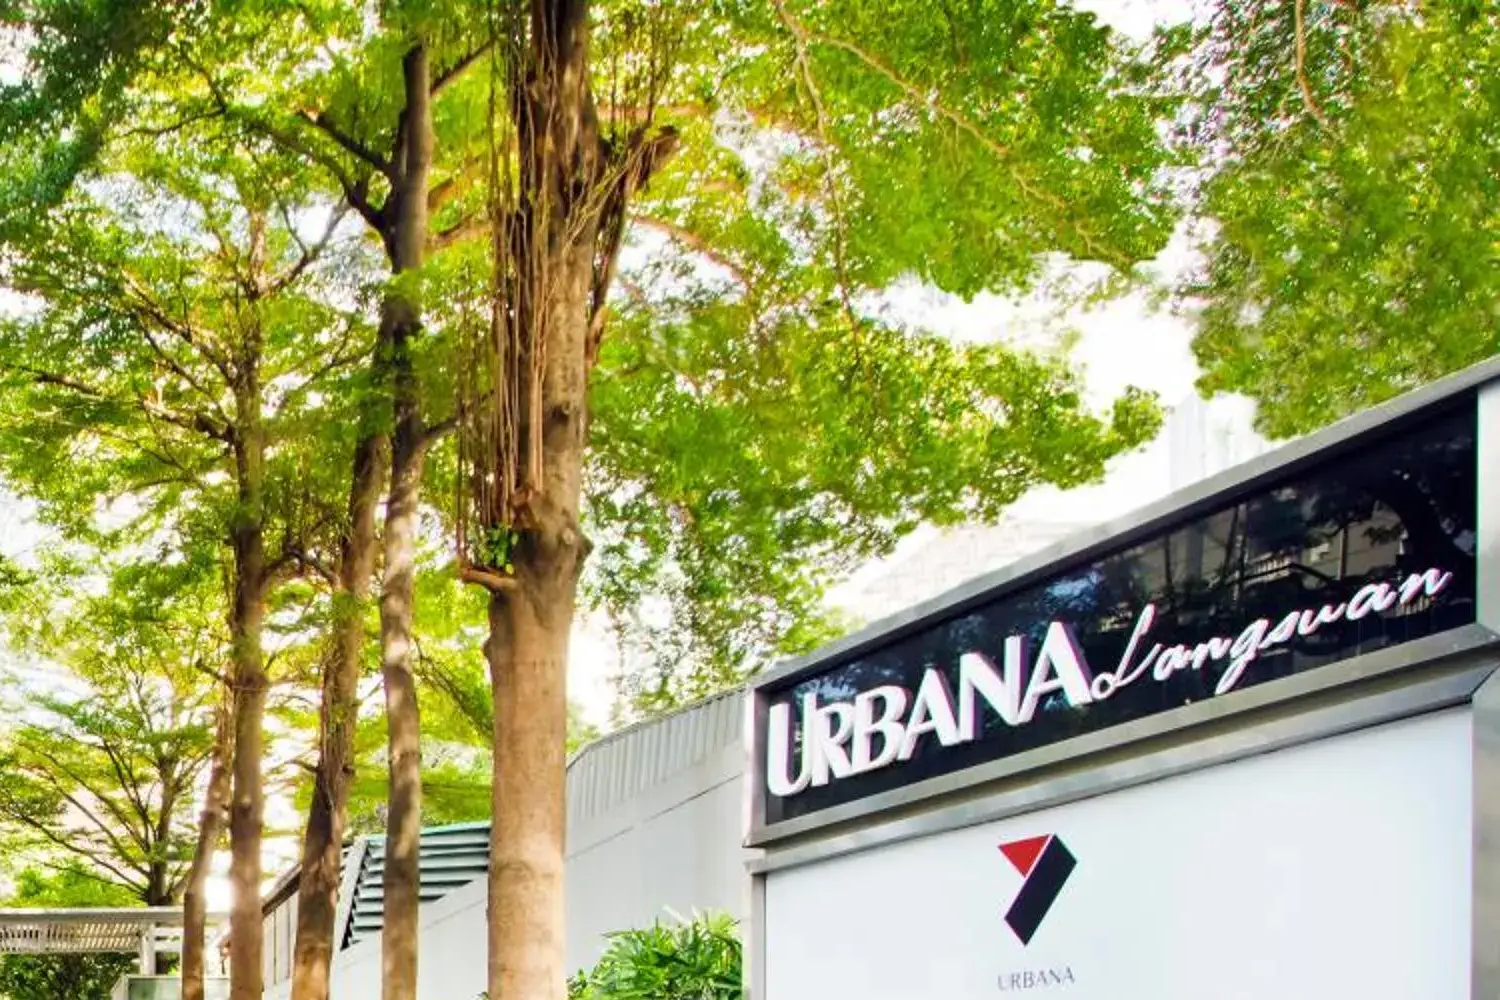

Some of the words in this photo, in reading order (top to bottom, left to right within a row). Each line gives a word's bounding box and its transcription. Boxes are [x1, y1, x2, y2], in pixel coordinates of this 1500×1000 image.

[766, 622, 1094, 798] URBANA
[1091, 566, 1453, 694] Langsuan
[997, 966, 1075, 991] URBANA
